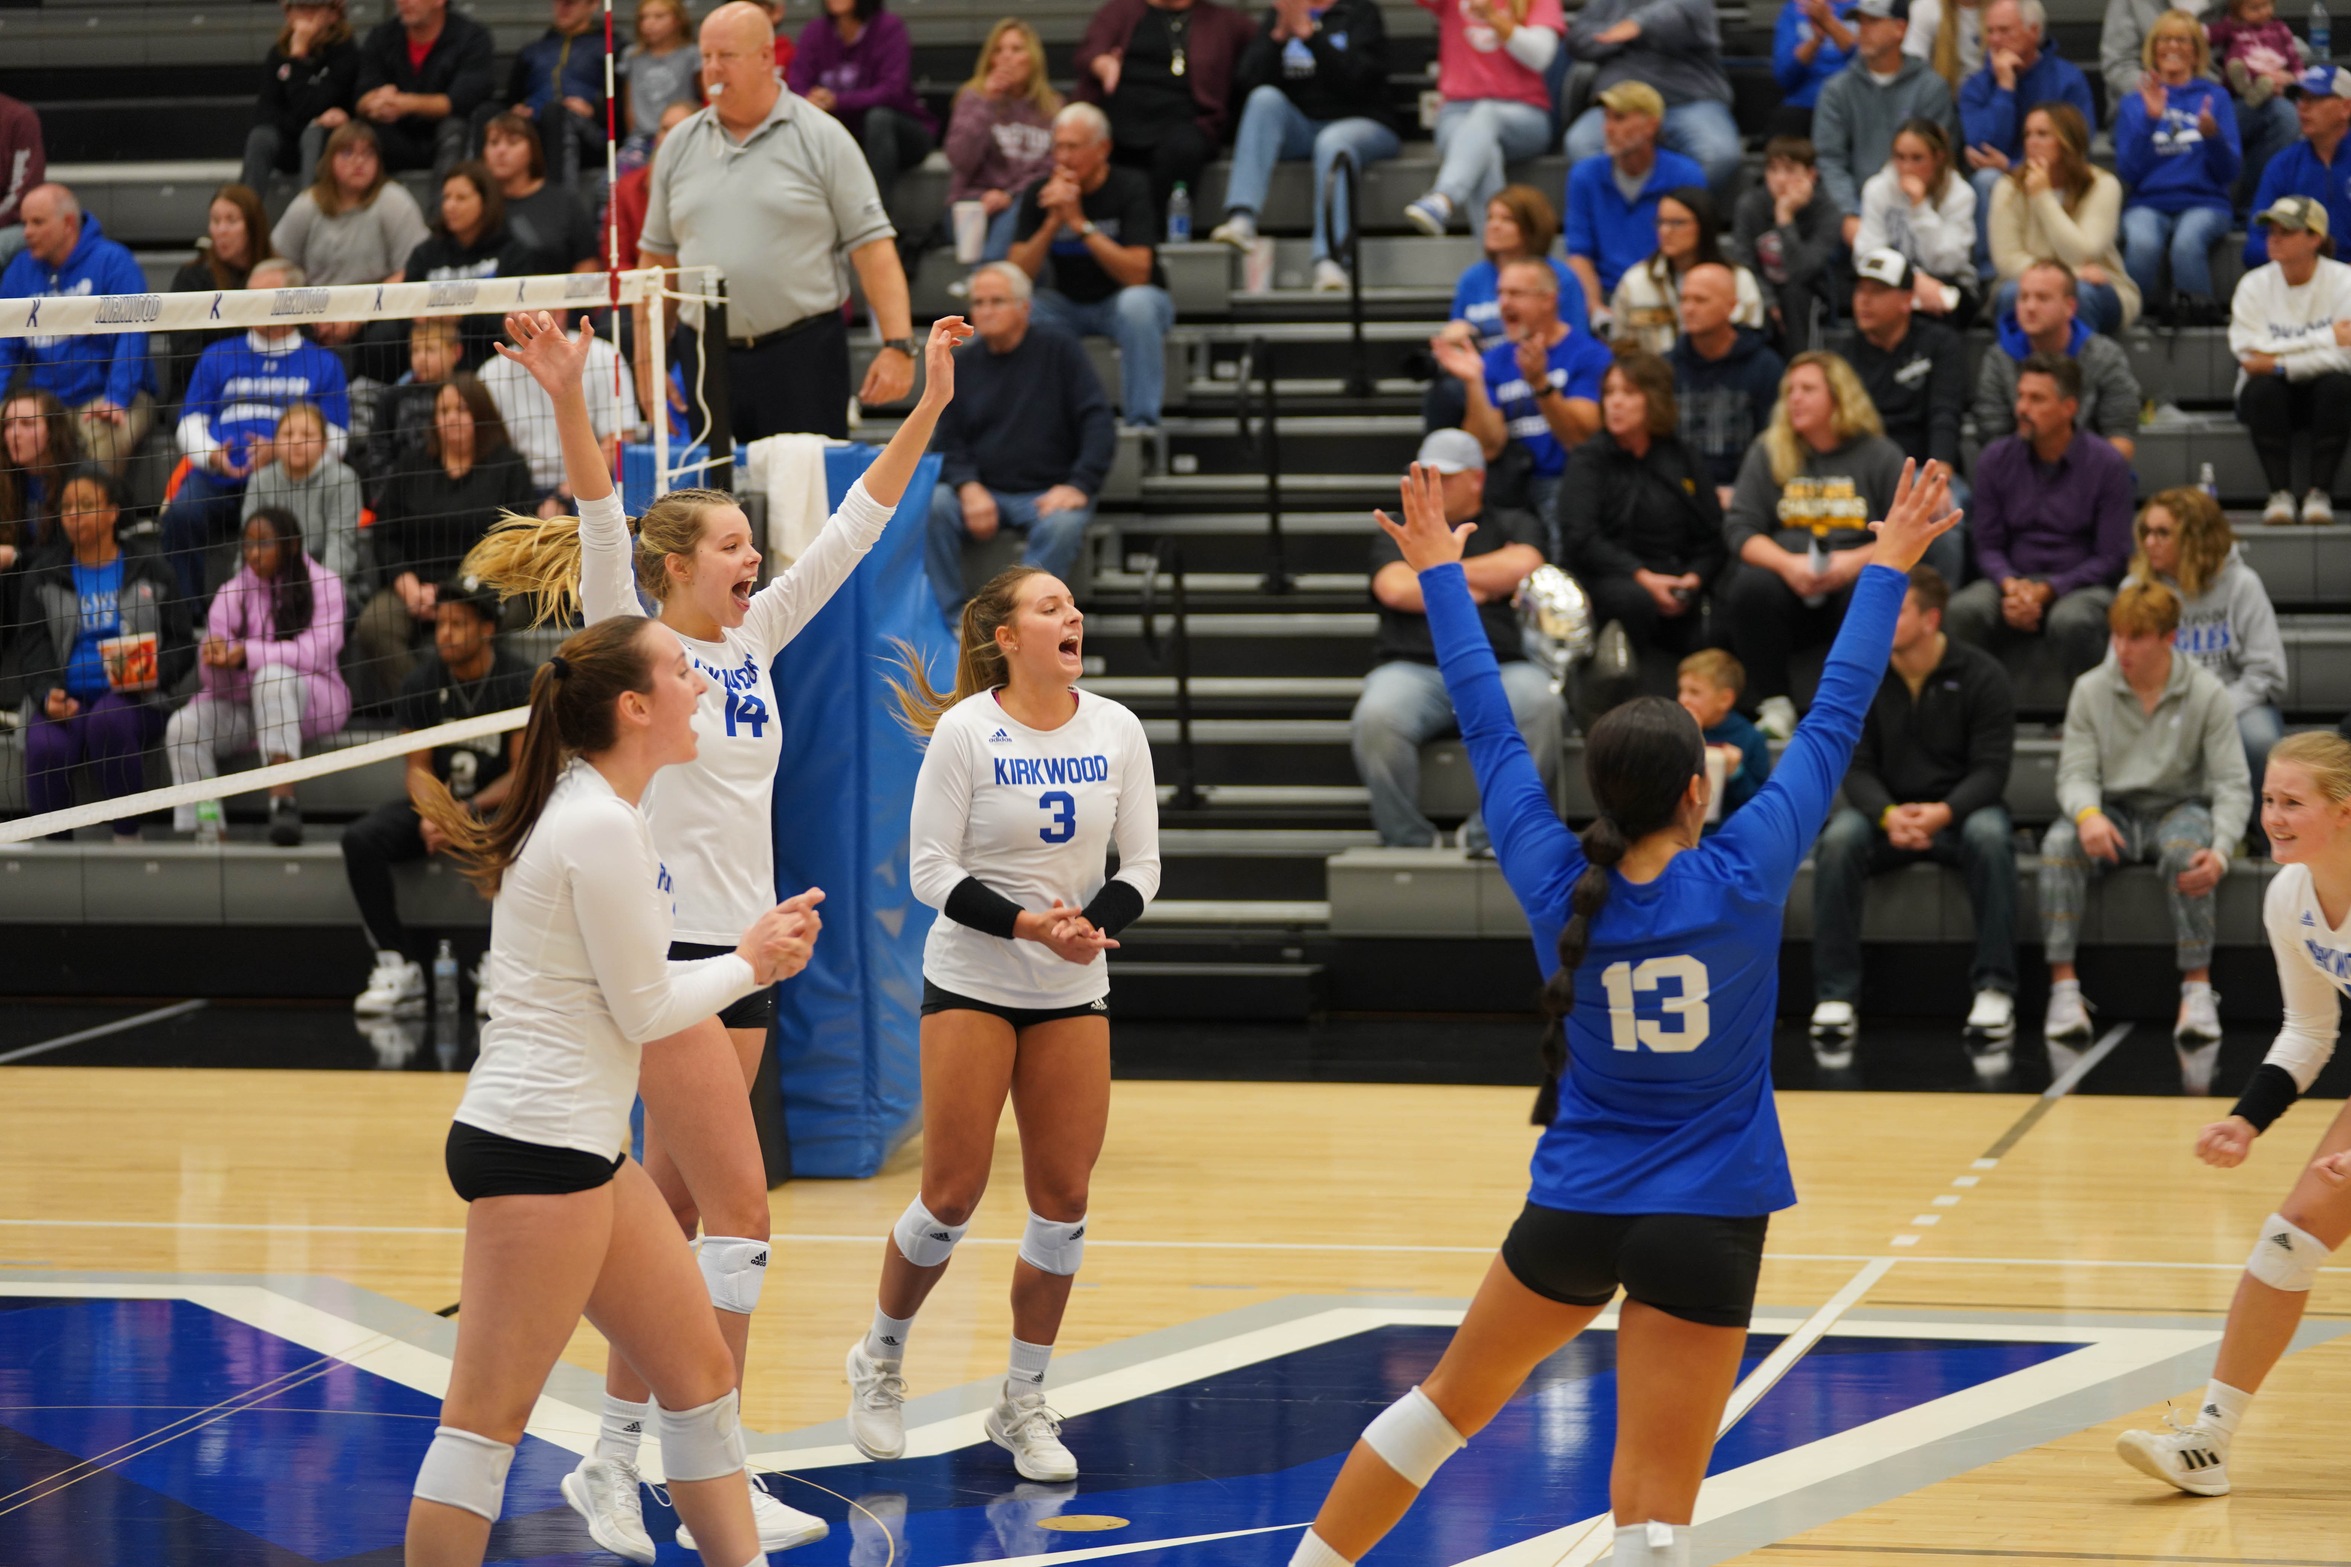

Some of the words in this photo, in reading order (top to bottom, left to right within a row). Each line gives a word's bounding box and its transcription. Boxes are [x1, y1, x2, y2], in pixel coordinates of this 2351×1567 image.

[26, 298, 41, 328] K
[210, 292, 223, 320] K
[725, 688, 769, 738] 14
[994, 755, 1108, 785] KIRKWOOD
[1039, 790, 1076, 843] 3
[1601, 954, 1710, 1053] 13
